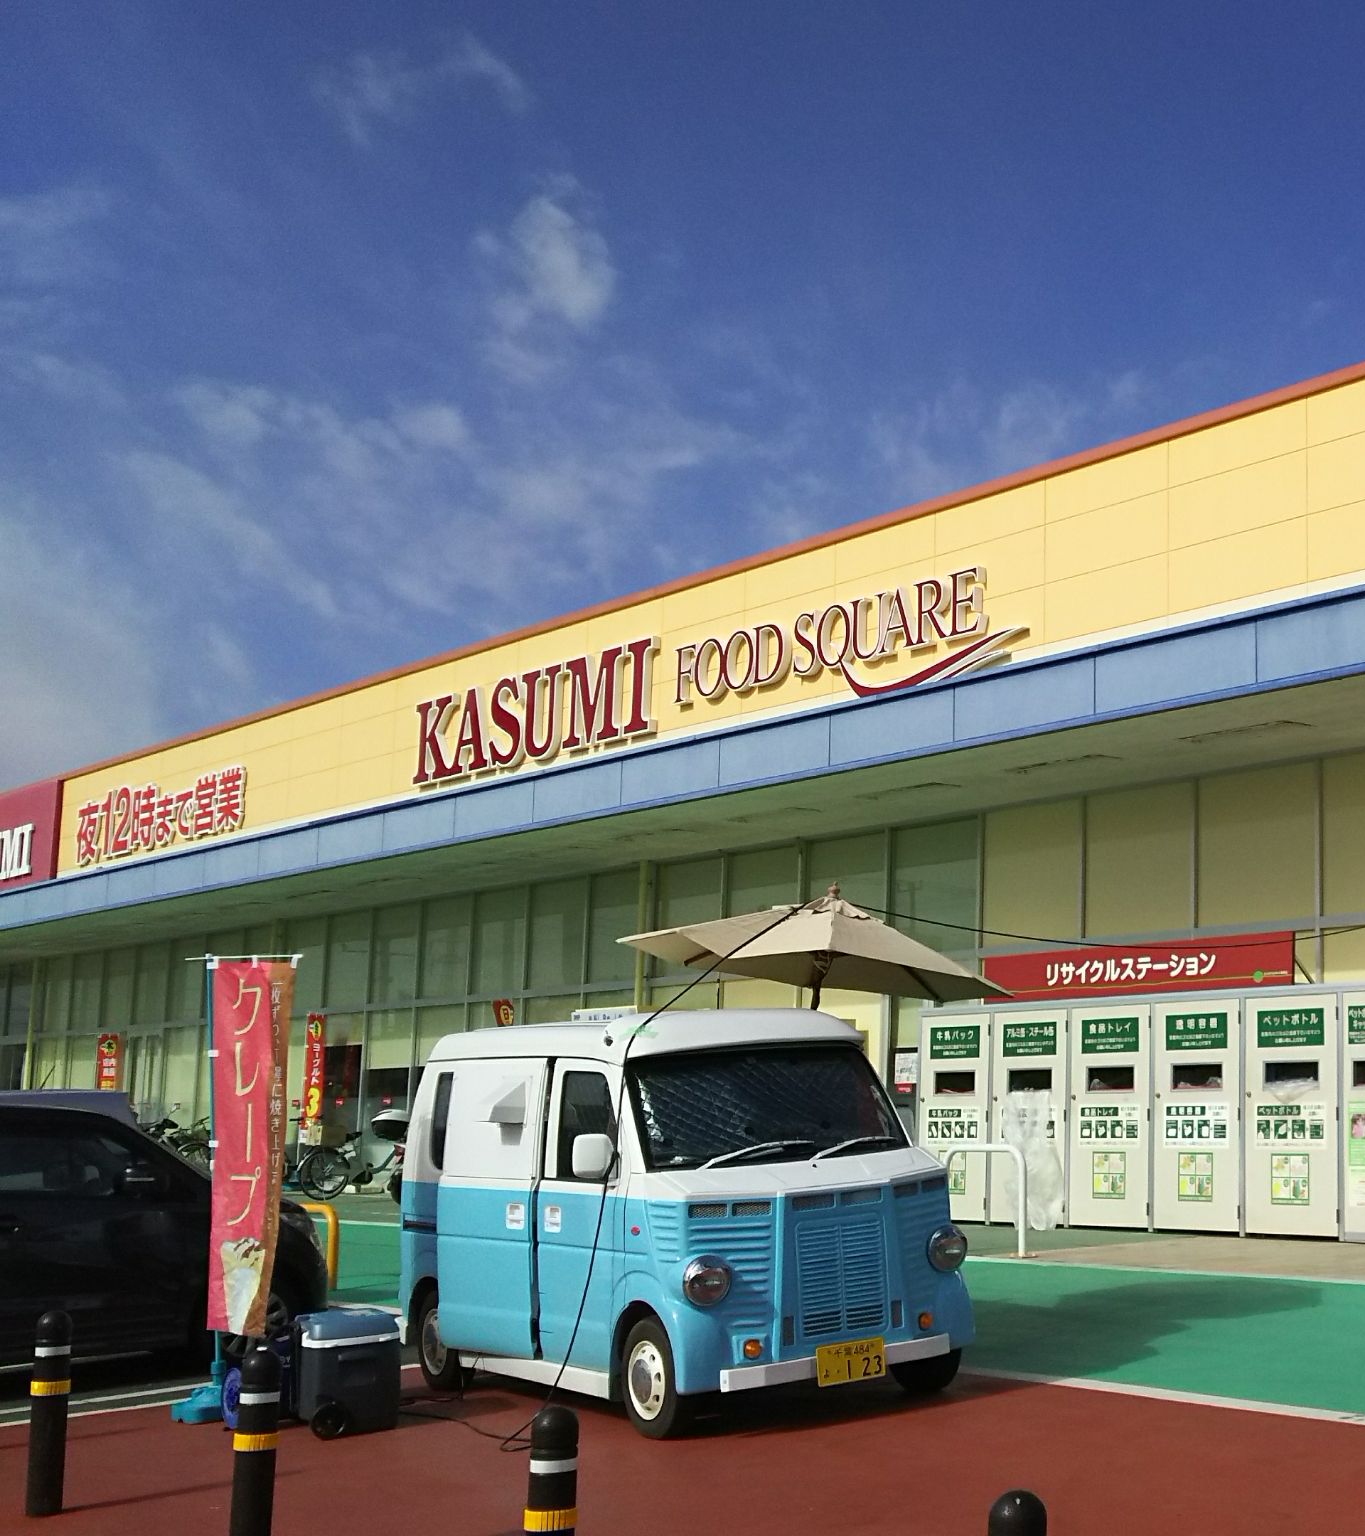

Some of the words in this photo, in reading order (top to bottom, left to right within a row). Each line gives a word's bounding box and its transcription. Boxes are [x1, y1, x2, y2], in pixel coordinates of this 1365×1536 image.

[412, 635, 660, 786] KASUMI
[674, 622, 793, 706] FOOD
[792, 565, 989, 680] SQUARE
[75, 764, 247, 867] 夜12時まで営業
[0, 823, 34, 880] MI
[1046, 952, 1216, 986] リサイクルステーション
[936, 1029, 974, 1041] 牛乳パック
[1088, 1021, 1132, 1035] 食品トレイ
[1263, 1012, 1319, 1026] ペットボトル
[311, 1043, 321, 1085] ヨーグルト
[226, 978, 262, 1226] クレープ
[306, 1086, 320, 1118] 3
